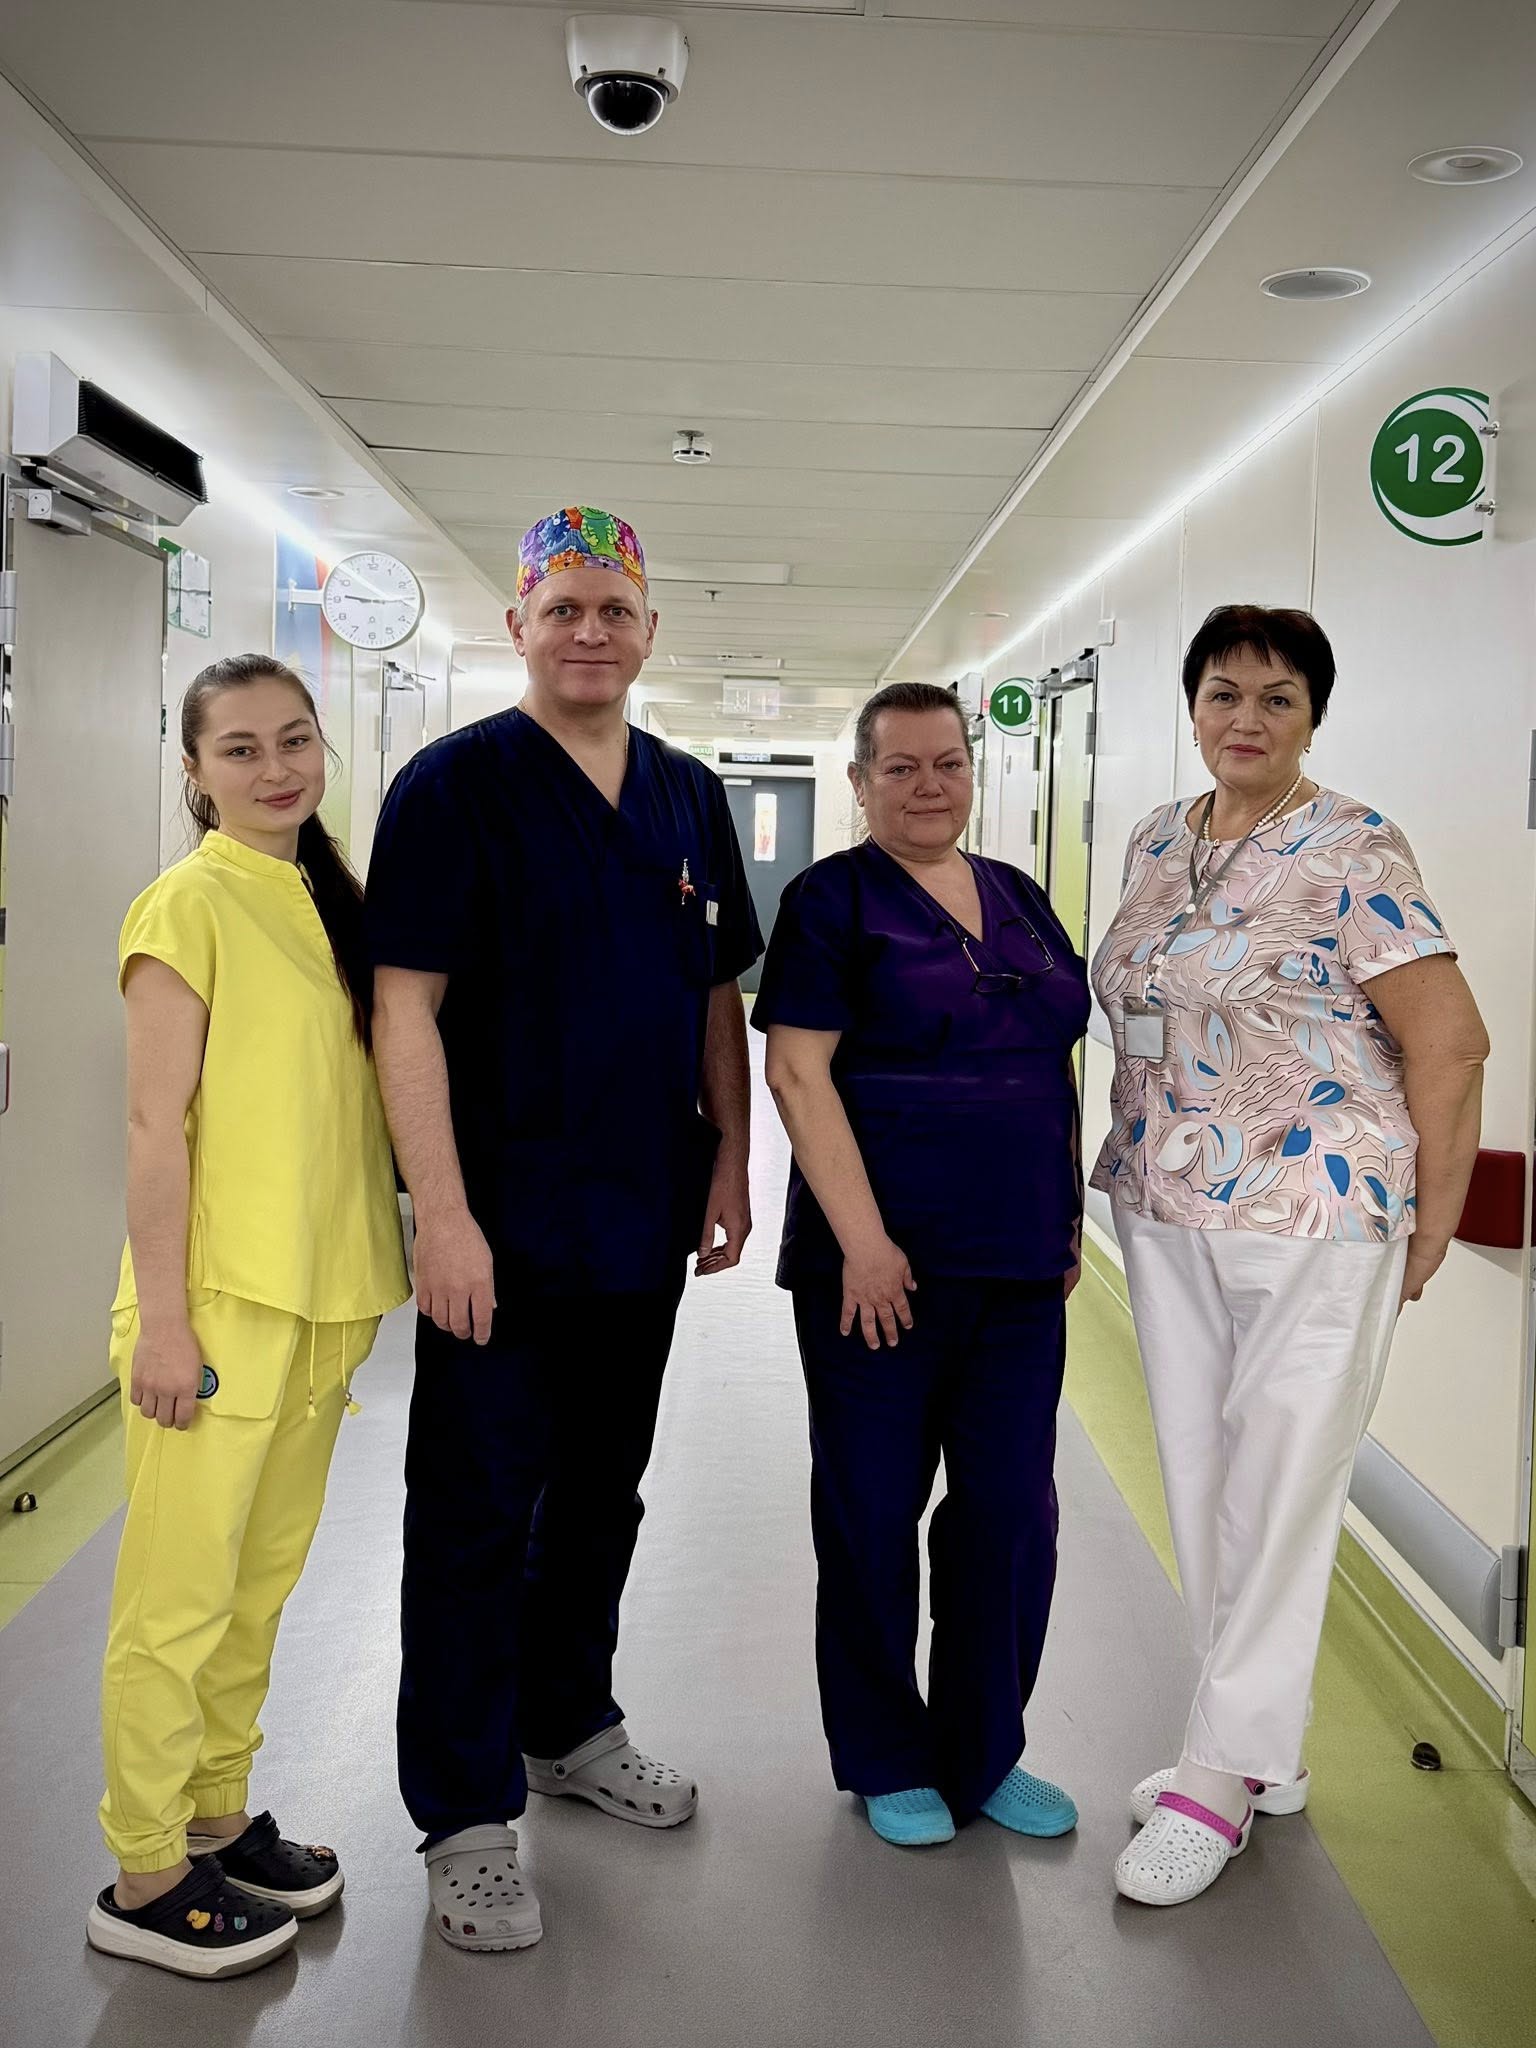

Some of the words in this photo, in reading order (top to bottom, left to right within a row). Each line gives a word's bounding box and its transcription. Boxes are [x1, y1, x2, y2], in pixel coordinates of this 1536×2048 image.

[1395, 433, 1466, 484] 12
[367, 563, 379, 571] 12
[398, 581, 406, 589] 2
[333, 595, 341, 604] 9
[339, 612, 347, 620] 8
[351, 625, 359, 633] 7
[385, 627, 394, 635] 5
[368, 632, 376, 640] 6
[998, 694, 1023, 714] 11
